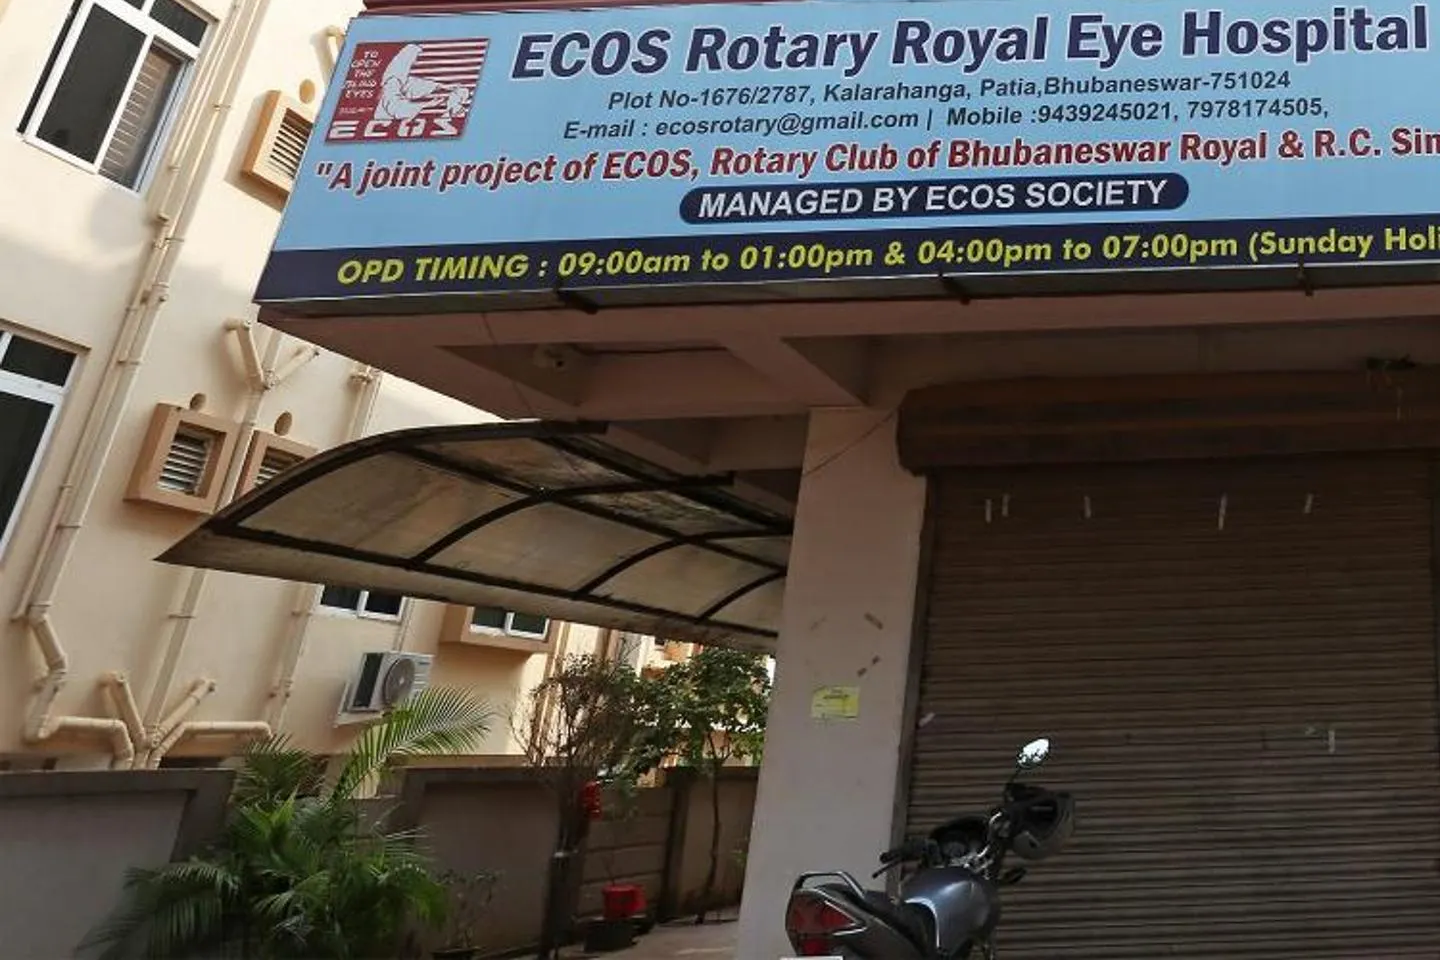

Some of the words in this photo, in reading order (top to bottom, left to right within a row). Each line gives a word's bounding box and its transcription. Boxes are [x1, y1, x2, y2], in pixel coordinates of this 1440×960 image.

[511, 28, 671, 79] ECOS
[684, 24, 878, 78] Rotary
[890, 15, 1050, 74] Royal
[1065, 13, 1163, 70] Eye
[1181, 4, 1428, 65] Hospital
[563, 120, 634, 139] E-mail
[655, 111, 919, 136] ecosrotary@gmail.com
[946, 106, 1023, 126] Mobile
[1187, 96, 1329, 118] 7978174505,
[608, 91, 653, 110] Plot
[659, 84, 816, 108] No-1676/2787,
[823, 80, 971, 103] Kalarahanga,
[356, 161, 434, 195] joint
[439, 155, 557, 192] project
[563, 152, 598, 182] of
[602, 148, 699, 181] ECOS,
[710, 145, 818, 179] Rotary
[825, 141, 898, 173] Club
[906, 139, 942, 169] of
[948, 138, 1171, 168] Bhubaneswar
[1180, 132, 1268, 166] Royal
[1277, 130, 1304, 159] &
[1314, 128, 1381, 157] R.C.
[698, 188, 864, 218] MANAGED
[872, 186, 919, 212] BY
[924, 183, 1017, 211] ECOS
[1024, 179, 1169, 208] SOCIETY
[336, 259, 405, 285] OPD
[413, 253, 529, 282] TIMING
[557, 250, 691, 276] 09:00am
[701, 248, 730, 272] to
[739, 243, 874, 272] 01:00pm
[883, 241, 906, 265] &
[917, 238, 1052, 267] 04:00pm
[1062, 238, 1092, 260] to
[1102, 233, 1238, 263] 07:00pm
[1248, 228, 1374, 262] (Sunday
